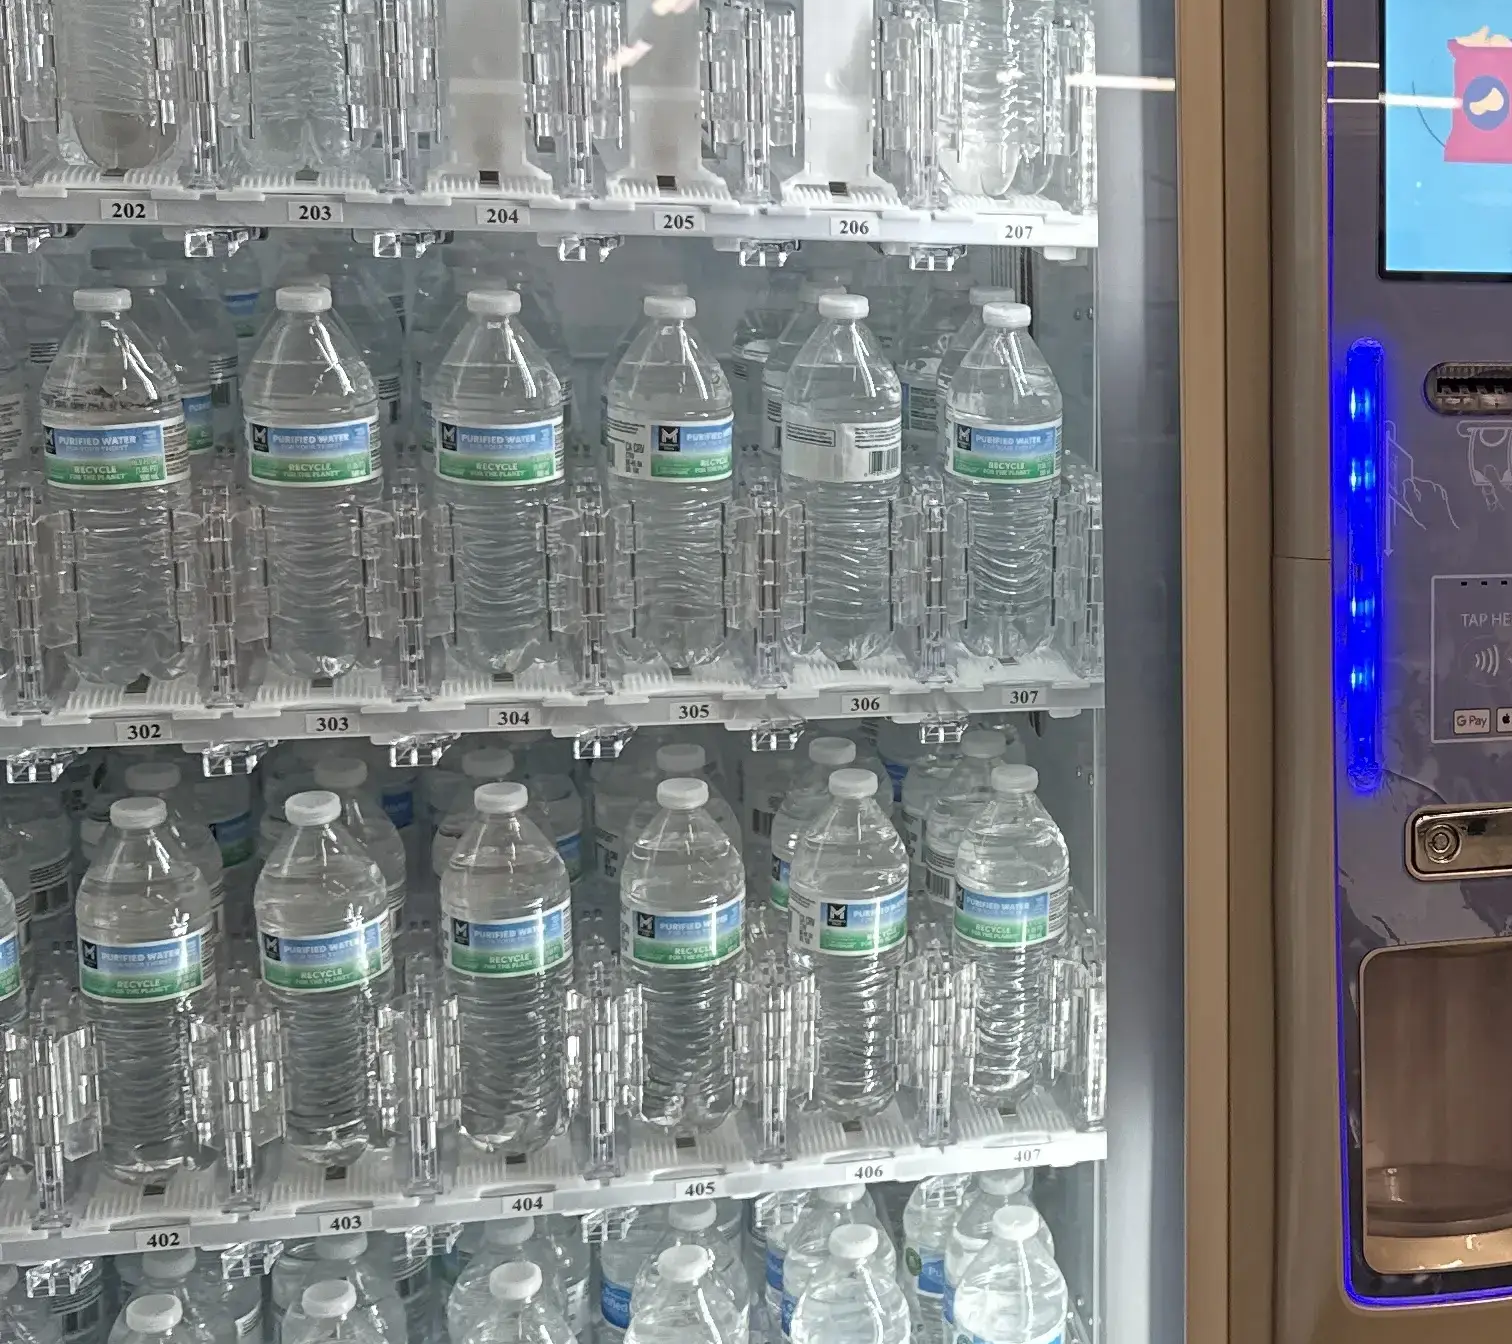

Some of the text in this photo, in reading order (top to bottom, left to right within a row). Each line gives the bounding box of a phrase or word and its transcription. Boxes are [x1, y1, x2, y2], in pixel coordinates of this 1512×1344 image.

[111, 202, 146, 219] 202
[299, 204, 332, 221] 203
[486, 208, 519, 225] 204
[663, 213, 694, 230] 205
[839, 219, 870, 236] 206
[1005, 224, 1033, 240] 207
[59, 435, 137, 446] PURIFIED WATER
[272, 433, 349, 444] PURIFIED WATER
[461, 433, 536, 444] PURIFIED WATER
[1461, 613, 1488, 628] TAP
[850, 697, 880, 712] 306
[1010, 690, 1039, 705] 307
[497, 710, 530, 727] 304
[679, 704, 710, 720] 305
[316, 716, 350, 733] 303
[1469, 715, 1487, 727] Pay
[127, 724, 162, 740] 302
[1013, 1147, 1041, 1163] 407
[854, 1163, 884, 1180] 406
[685, 1180, 716, 1197] 405
[512, 1196, 544, 1213] 404
[330, 1215, 363, 1232] 403
[146, 1232, 180, 1249] 402
